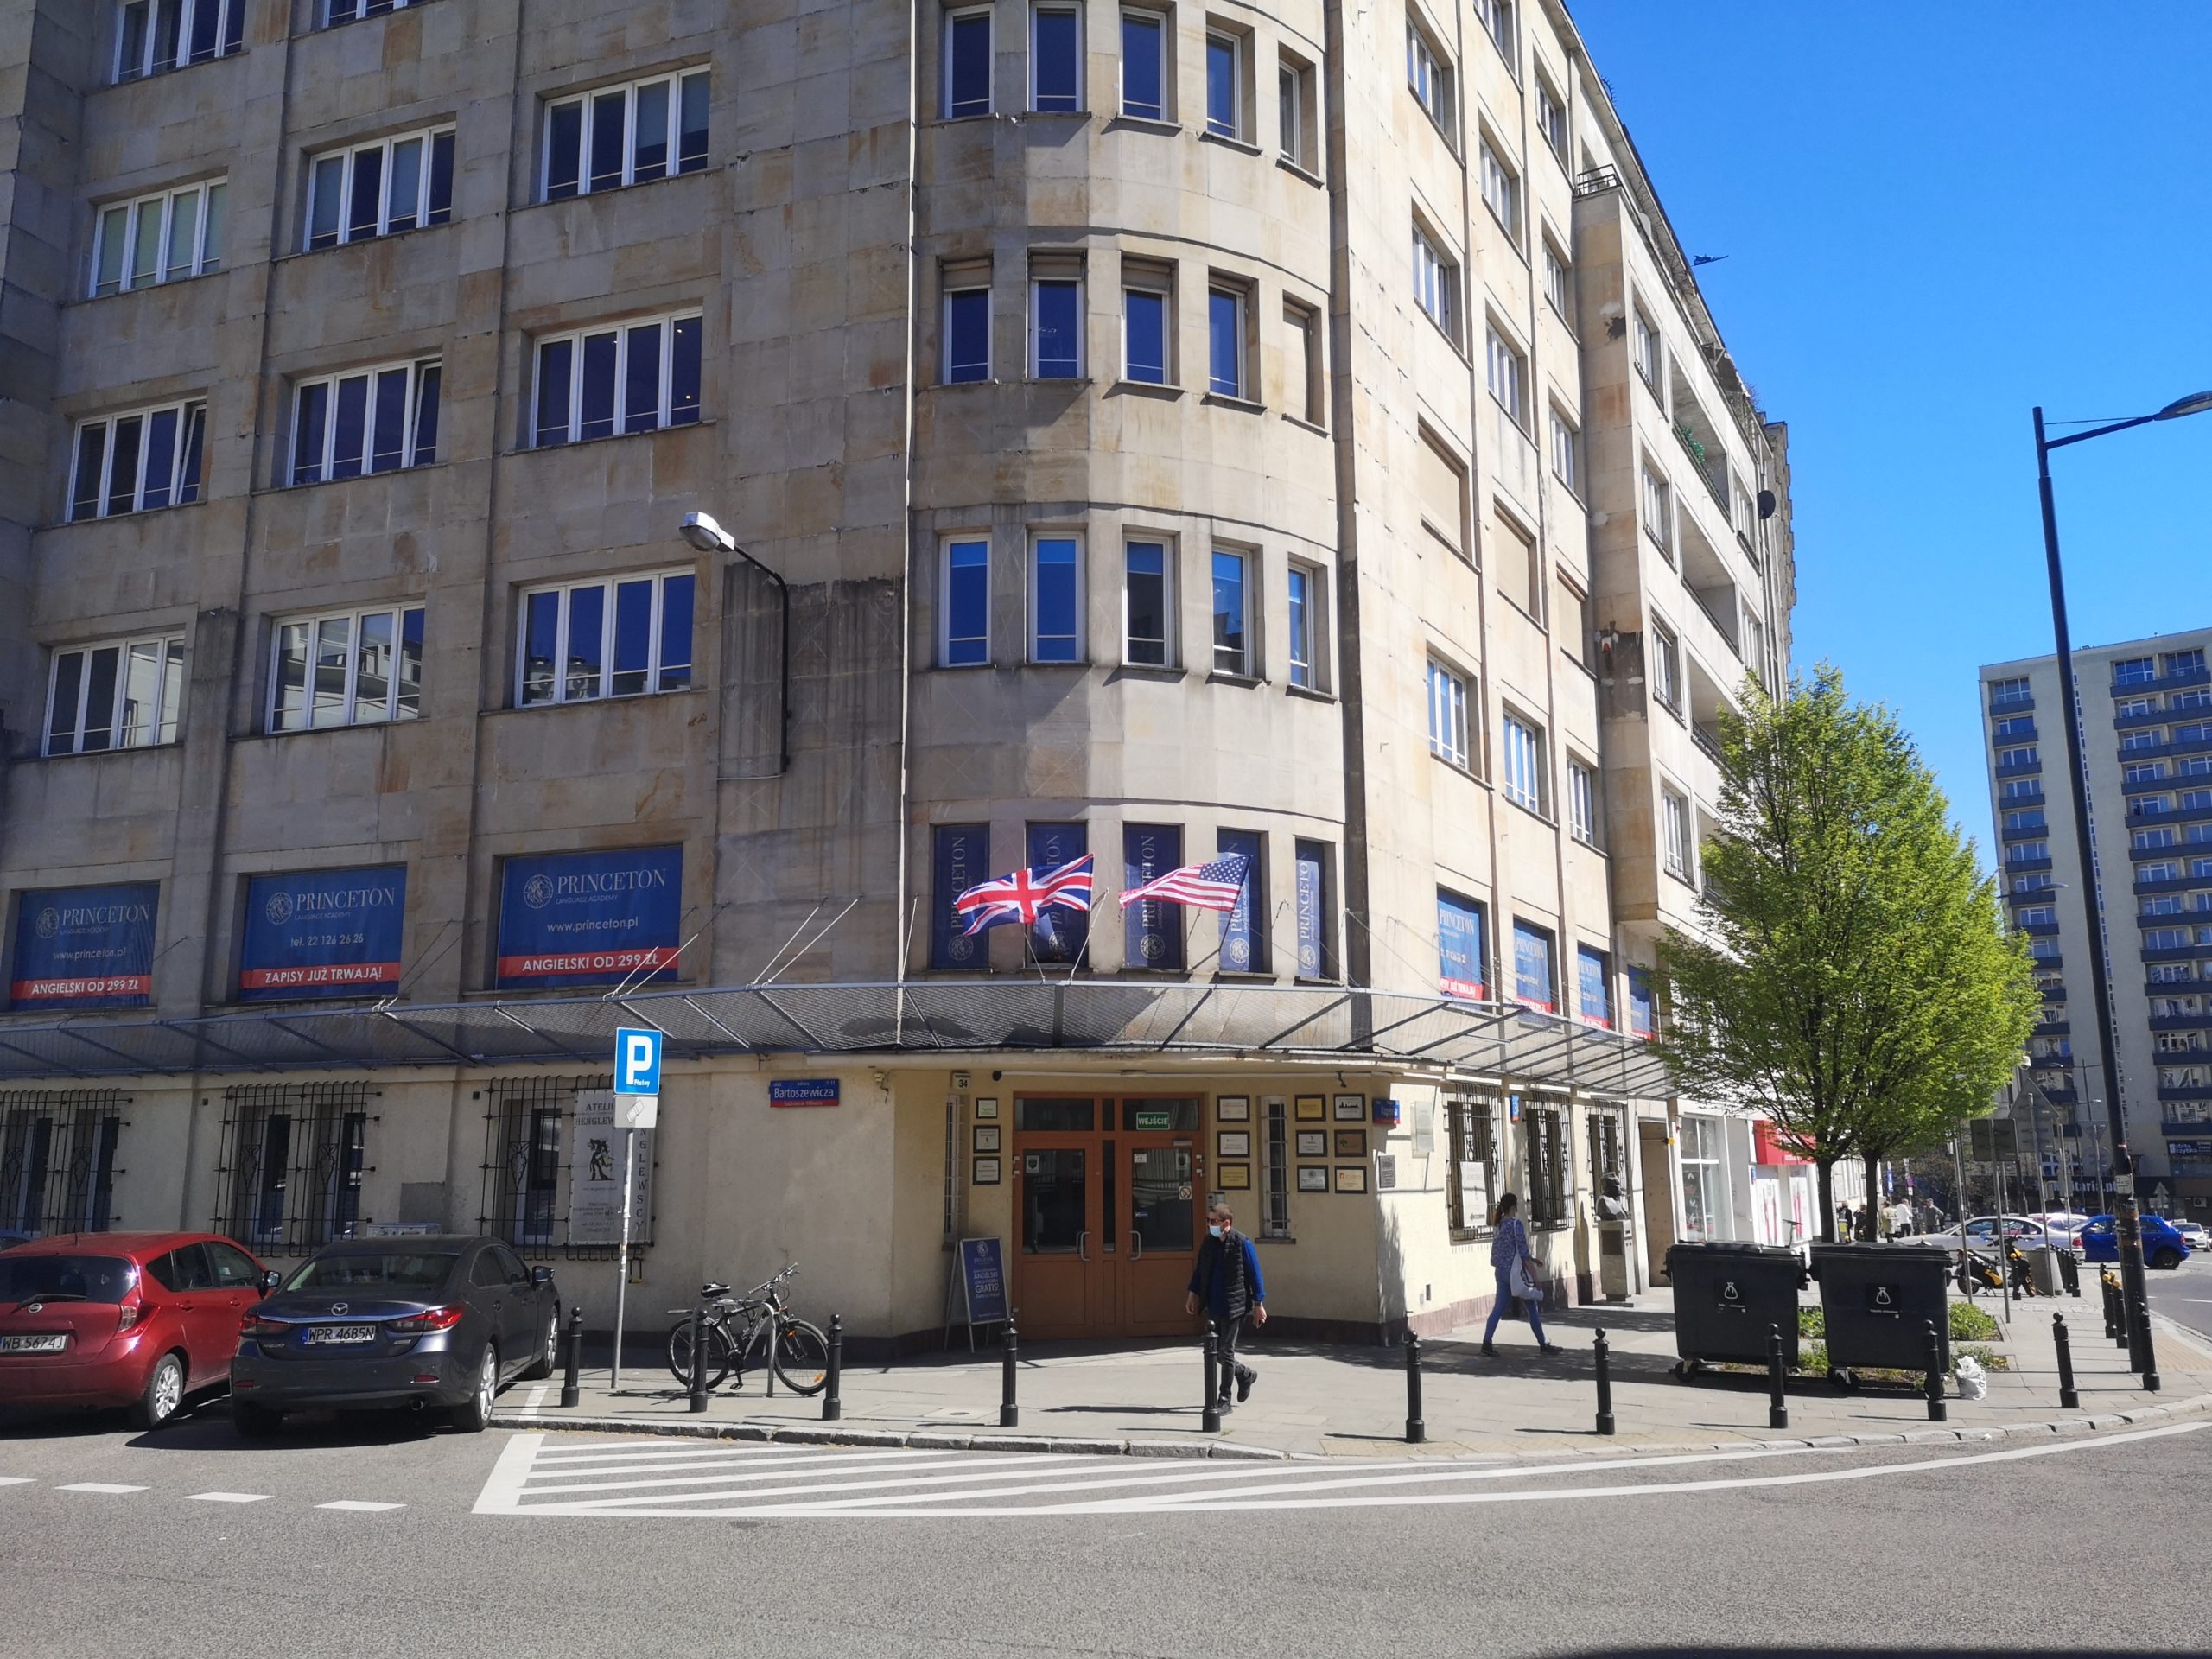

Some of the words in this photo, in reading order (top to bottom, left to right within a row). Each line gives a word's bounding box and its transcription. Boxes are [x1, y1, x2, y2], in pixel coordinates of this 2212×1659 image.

[557, 868, 667, 894] PRINCETON
[950, 836, 966, 929] PRCETON
[1141, 836, 1155, 927] PRIETON
[296, 887, 396, 911] PRINCETON
[1299, 853, 1310, 940] PRINCETON
[61, 904, 150, 926] PRINCETON
[547, 917, 639, 932] www.princeton.pl
[290, 937, 304, 947] tel.
[307, 936, 318, 946] 22
[321, 935, 336, 945] 126
[340, 934, 351, 944] 26
[353, 933, 364, 944] 26
[54, 947, 126, 961] www.princeton.pl
[522, 957, 589, 971] ANGIELSKI
[594, 956, 614, 969] OD
[618, 954, 640, 968] 299
[264, 970, 304, 983] ZAPISY
[307, 967, 327, 982] JUŻ
[331, 966, 383, 980] TRWAJĄ!
[31, 982, 85, 995] ANGIELSKI
[87, 981, 105, 992] OD
[106, 980, 124, 991] 299
[128, 979, 139, 990] ZŁ
[626, 1035, 653, 1085] P
[958, 1079, 968, 1088] 34
[774, 1086, 834, 1098] Bartoszewicza
[585, 1103, 613, 1112] ATELI
[1138, 1116, 1168, 1125] WEJŚCIE
[308, 1328, 331, 1340] WPR
[336, 1327, 375, 1340] 4685N
[3, 1337, 21, 1350] WB
[25, 1336, 63, 1349] 5674J
